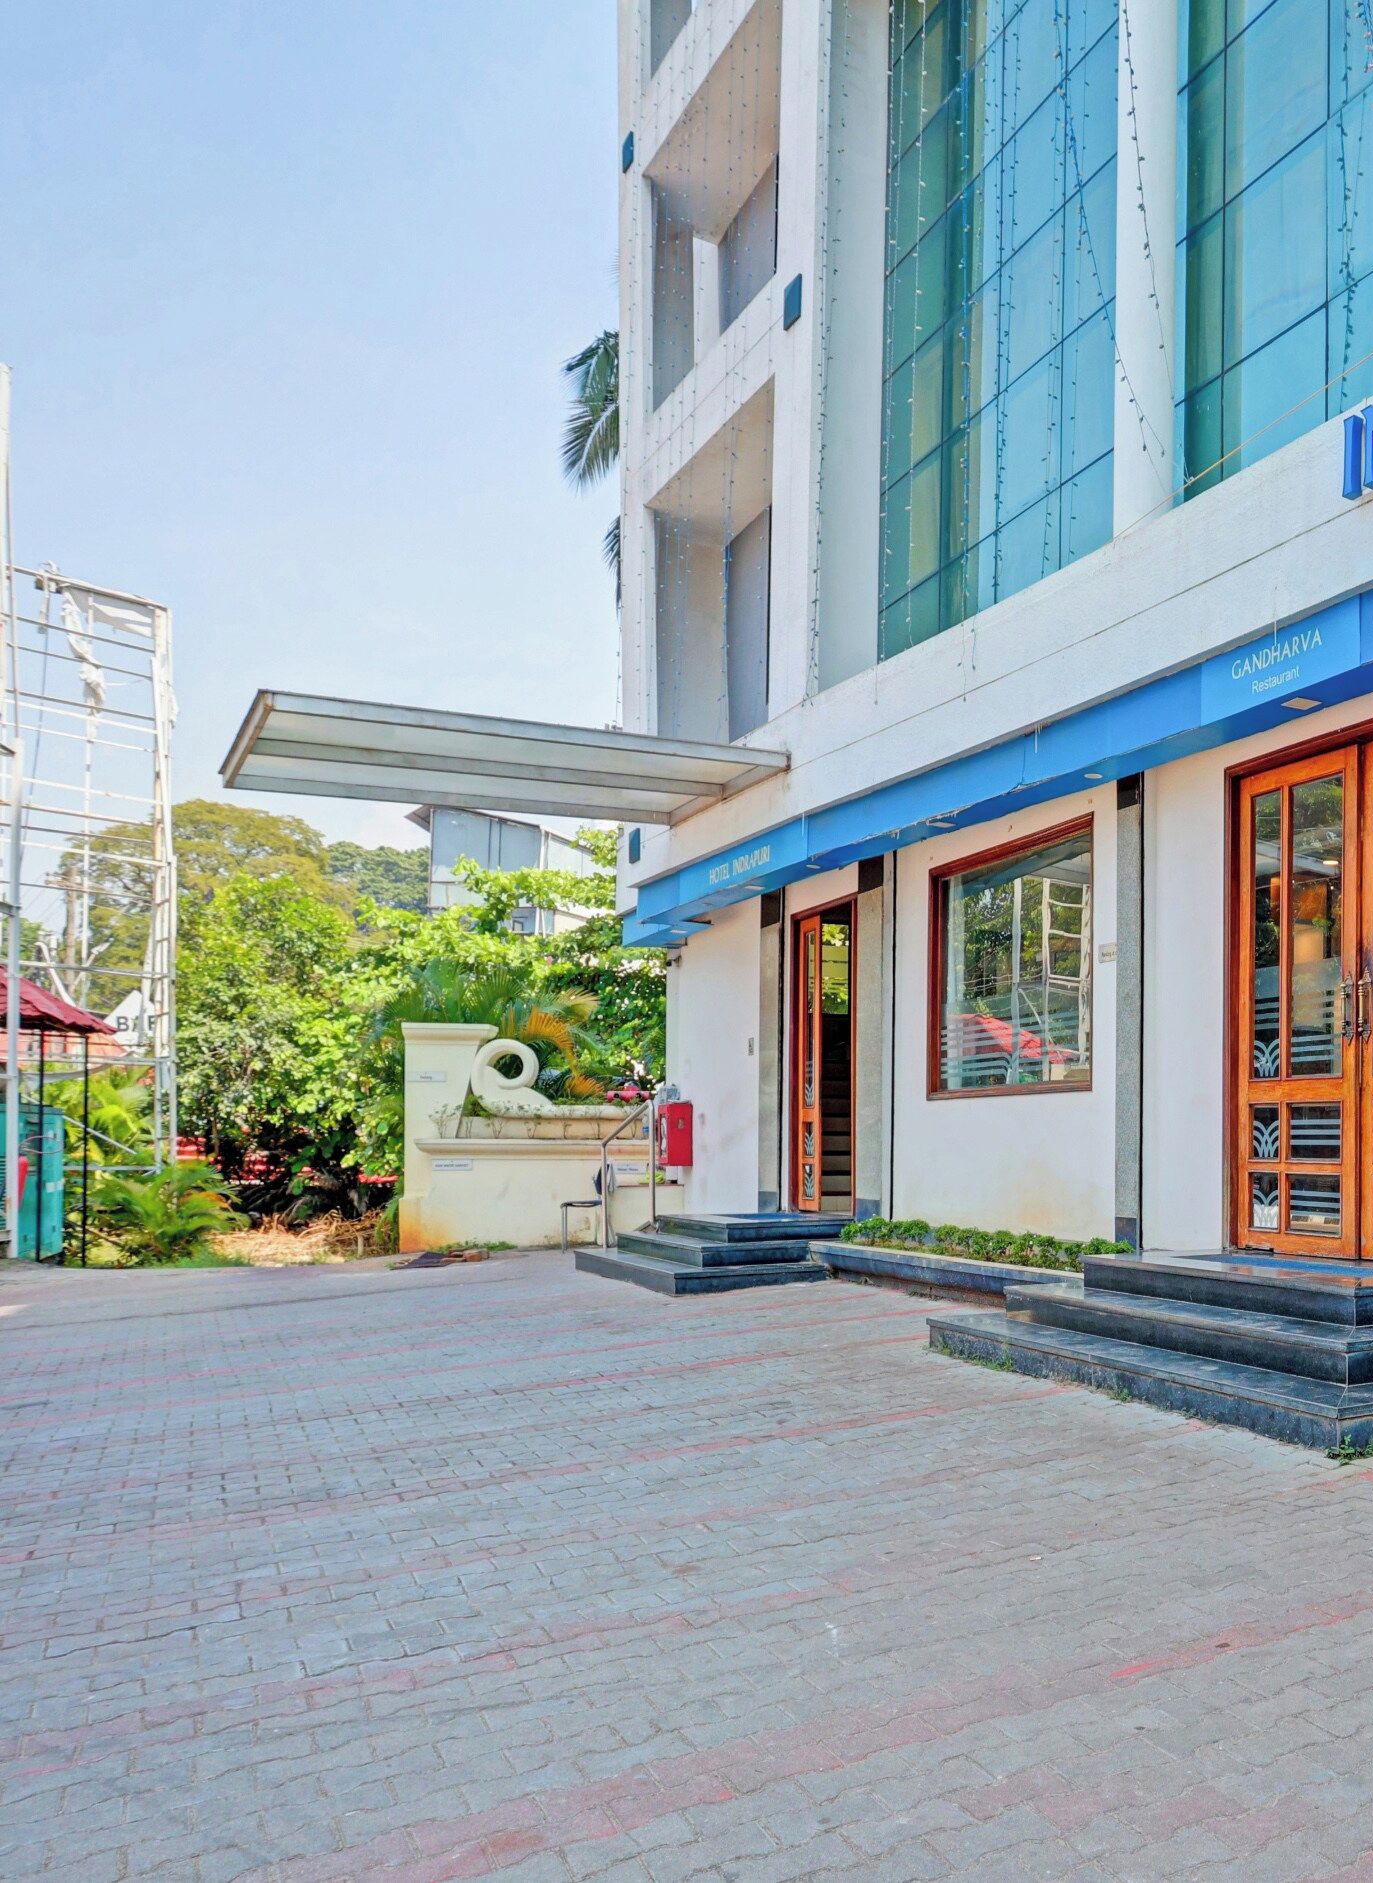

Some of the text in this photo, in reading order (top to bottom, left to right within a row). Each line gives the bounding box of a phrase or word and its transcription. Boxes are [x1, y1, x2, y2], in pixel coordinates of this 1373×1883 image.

[1232, 628, 1322, 680] GANDHARVA
[1252, 665, 1300, 694] Restaurant
[710, 845, 770, 885] HOTEL INDRAPURI
